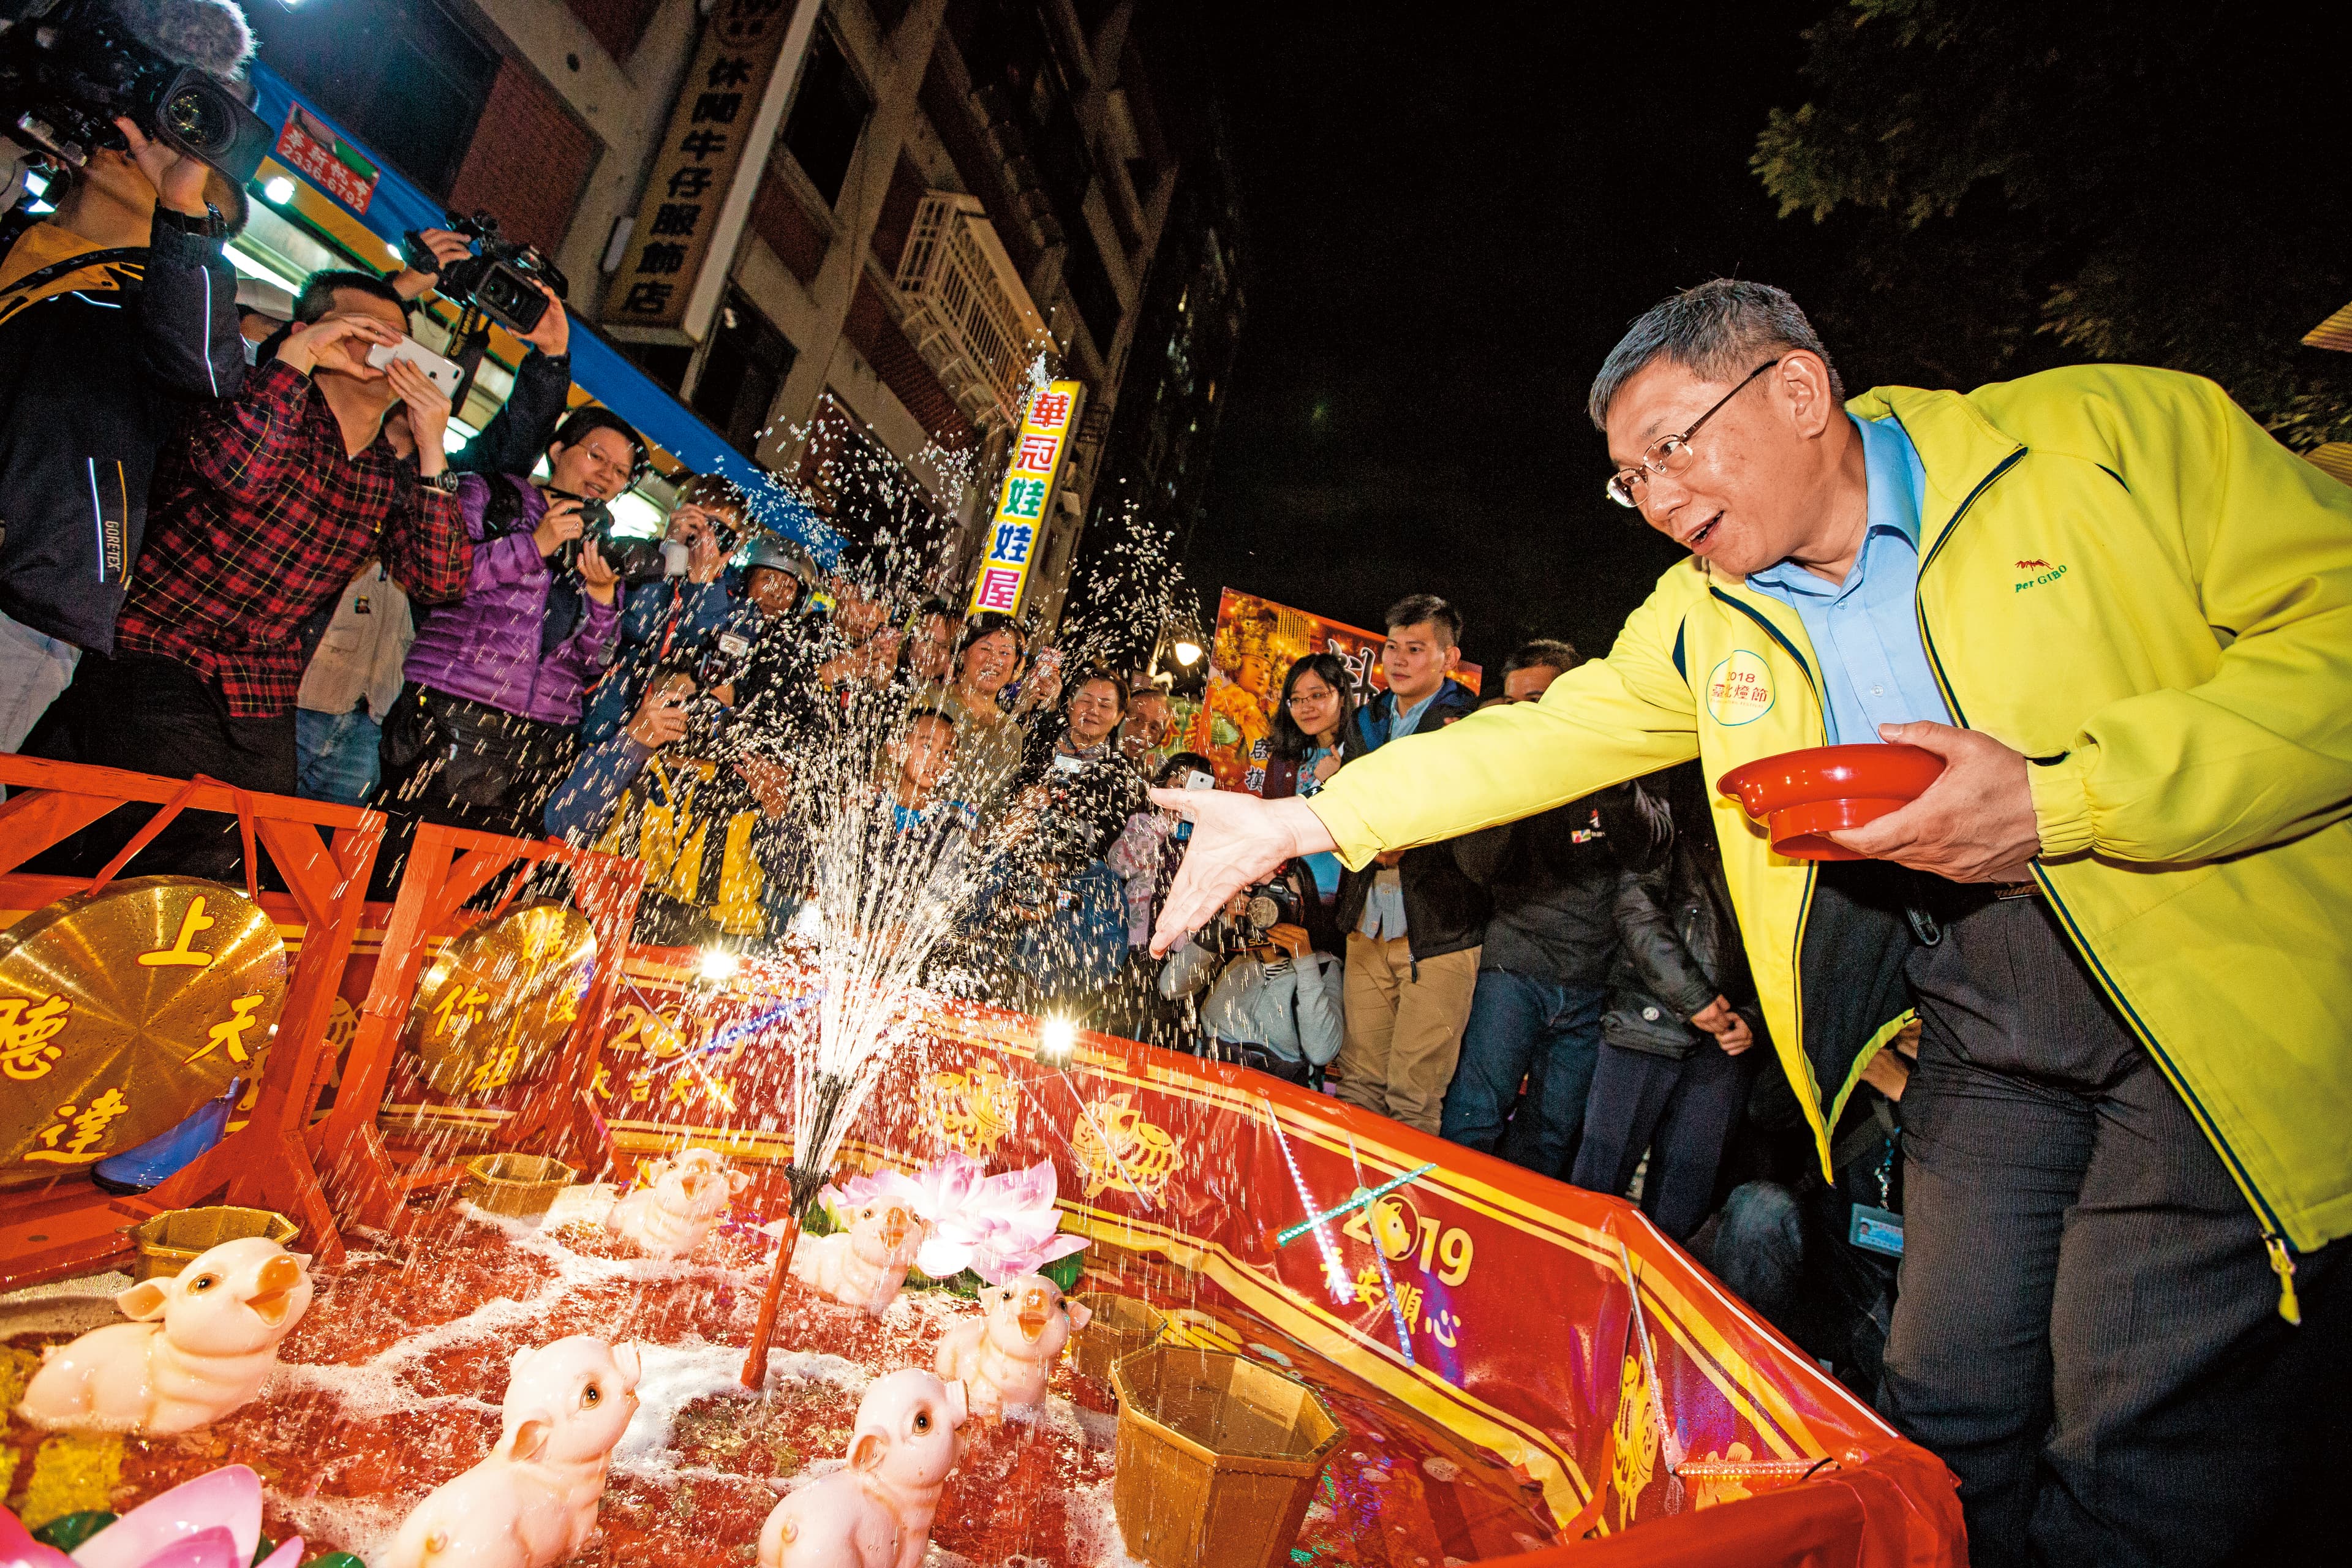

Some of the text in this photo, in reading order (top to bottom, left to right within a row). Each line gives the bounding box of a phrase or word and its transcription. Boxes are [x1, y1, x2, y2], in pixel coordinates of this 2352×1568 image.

[282, 144, 364, 213] 2336-6792
[976, 391, 1071, 611] 華冠娃娃屋
[105, 520, 121, 572] GORE-TEX
[2015, 565, 2067, 593] per GIBO
[136, 894, 215, 967] 上
[184, 993, 265, 1065] 天
[20, 1087, 129, 1163] 達
